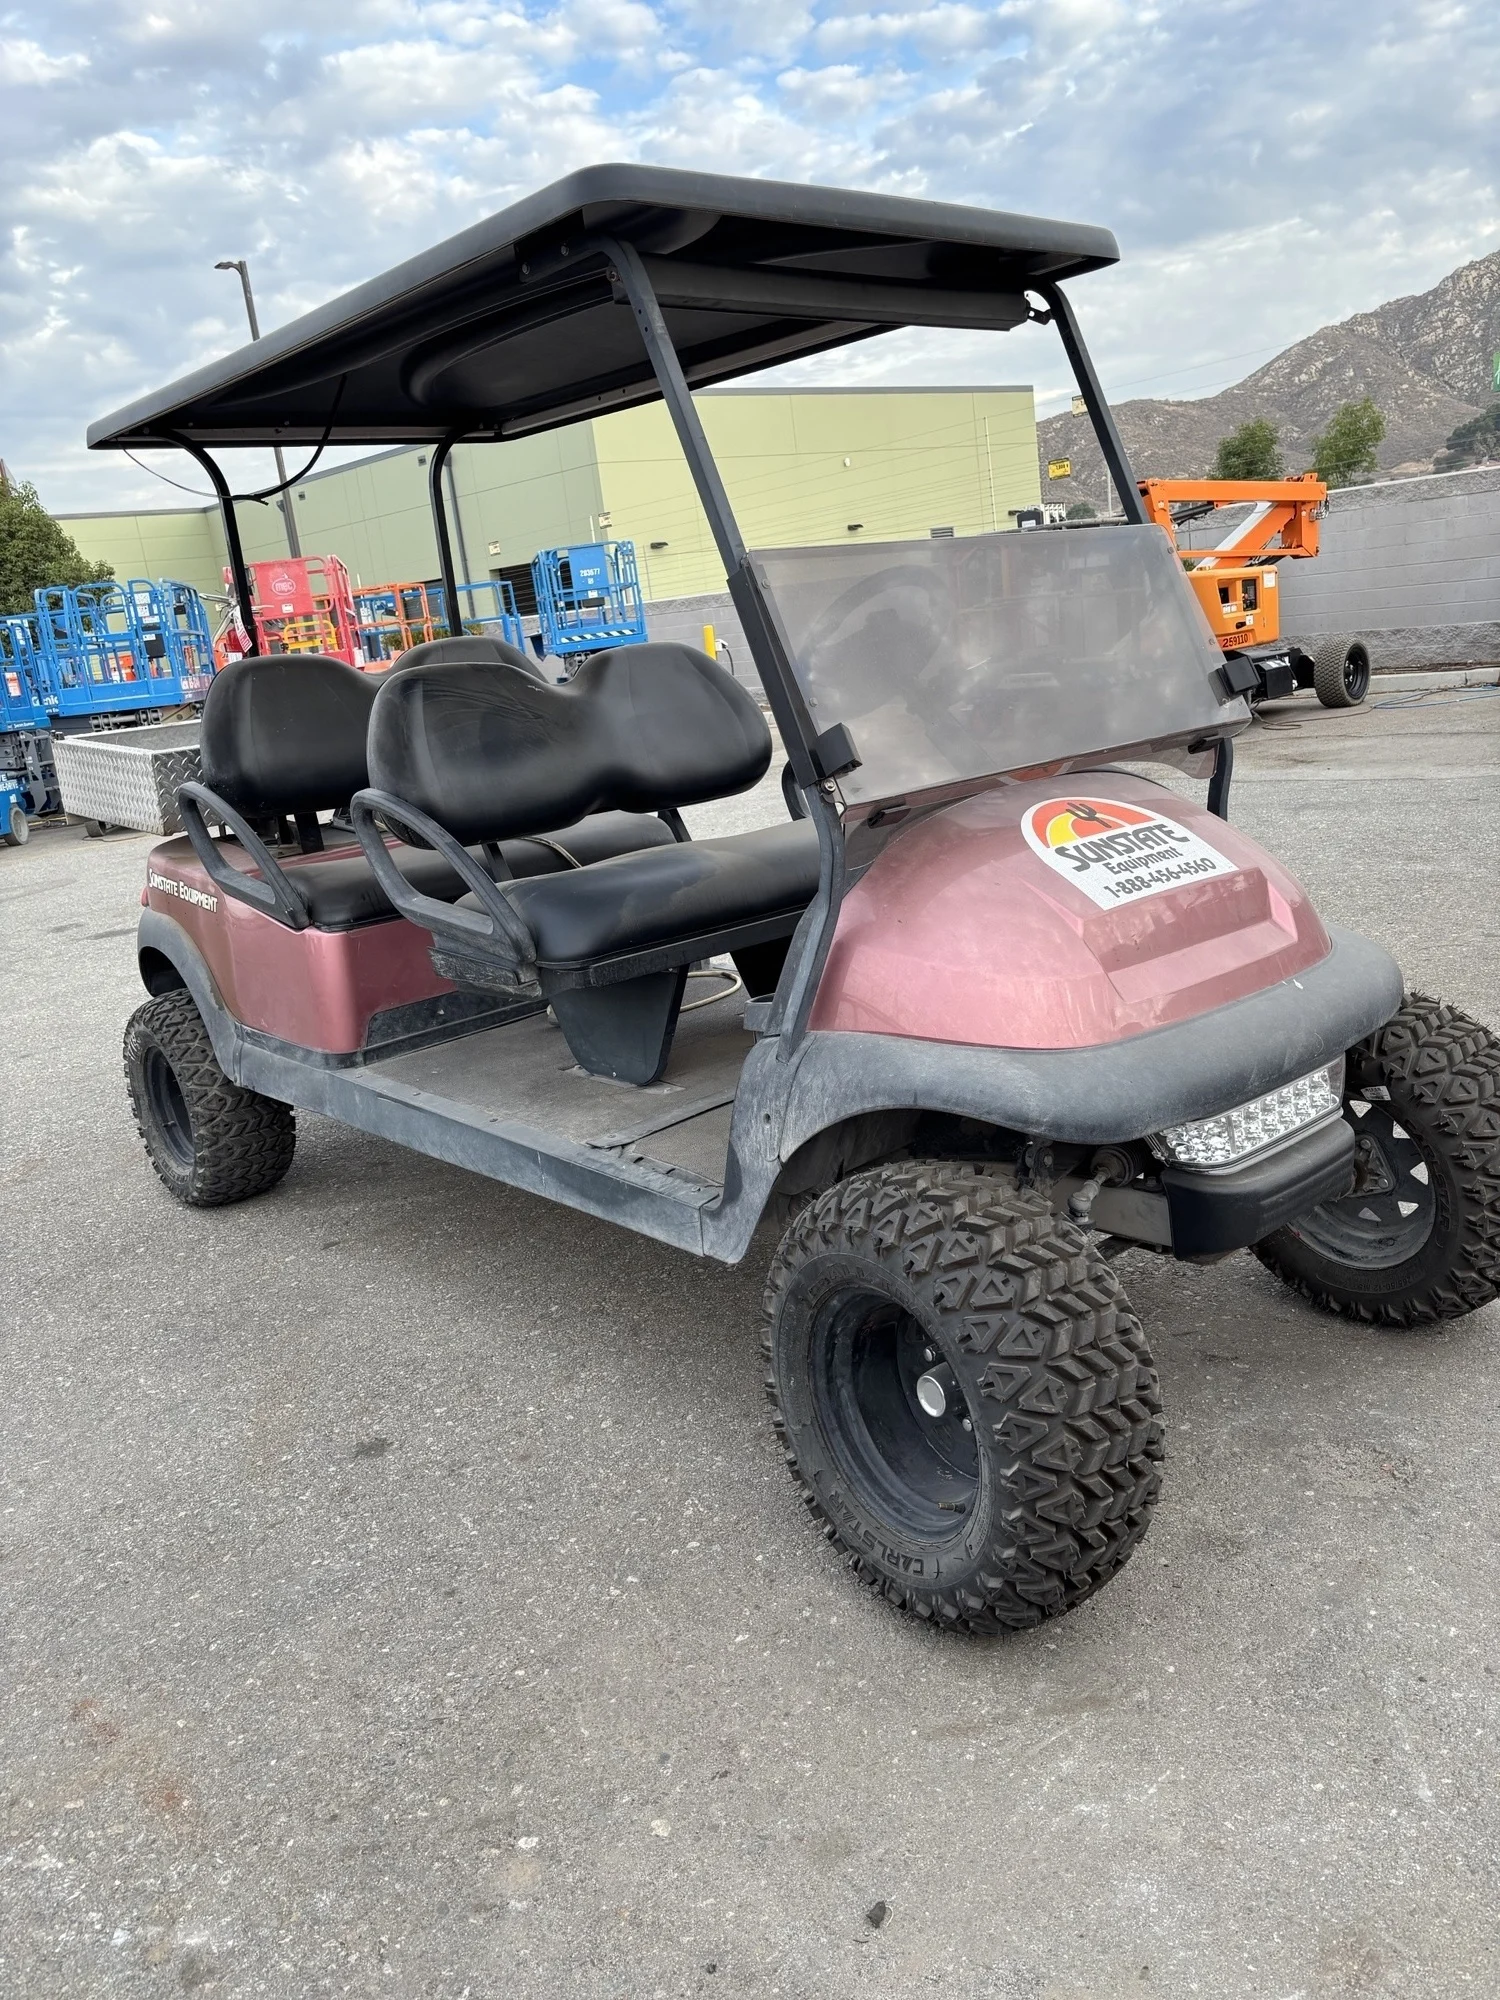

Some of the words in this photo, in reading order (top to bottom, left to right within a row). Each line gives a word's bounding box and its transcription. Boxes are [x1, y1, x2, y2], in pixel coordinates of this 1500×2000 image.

[1222, 633, 1249, 648] 259110
[1054, 823, 1190, 873] SUNSTATE
[1102, 846, 1183, 875] Equipment
[1103, 857, 1217, 899] 1-888-456-4560
[179, 881, 218, 913] EQUIPMENT
[828, 1489, 925, 1577] CARLSTAR
